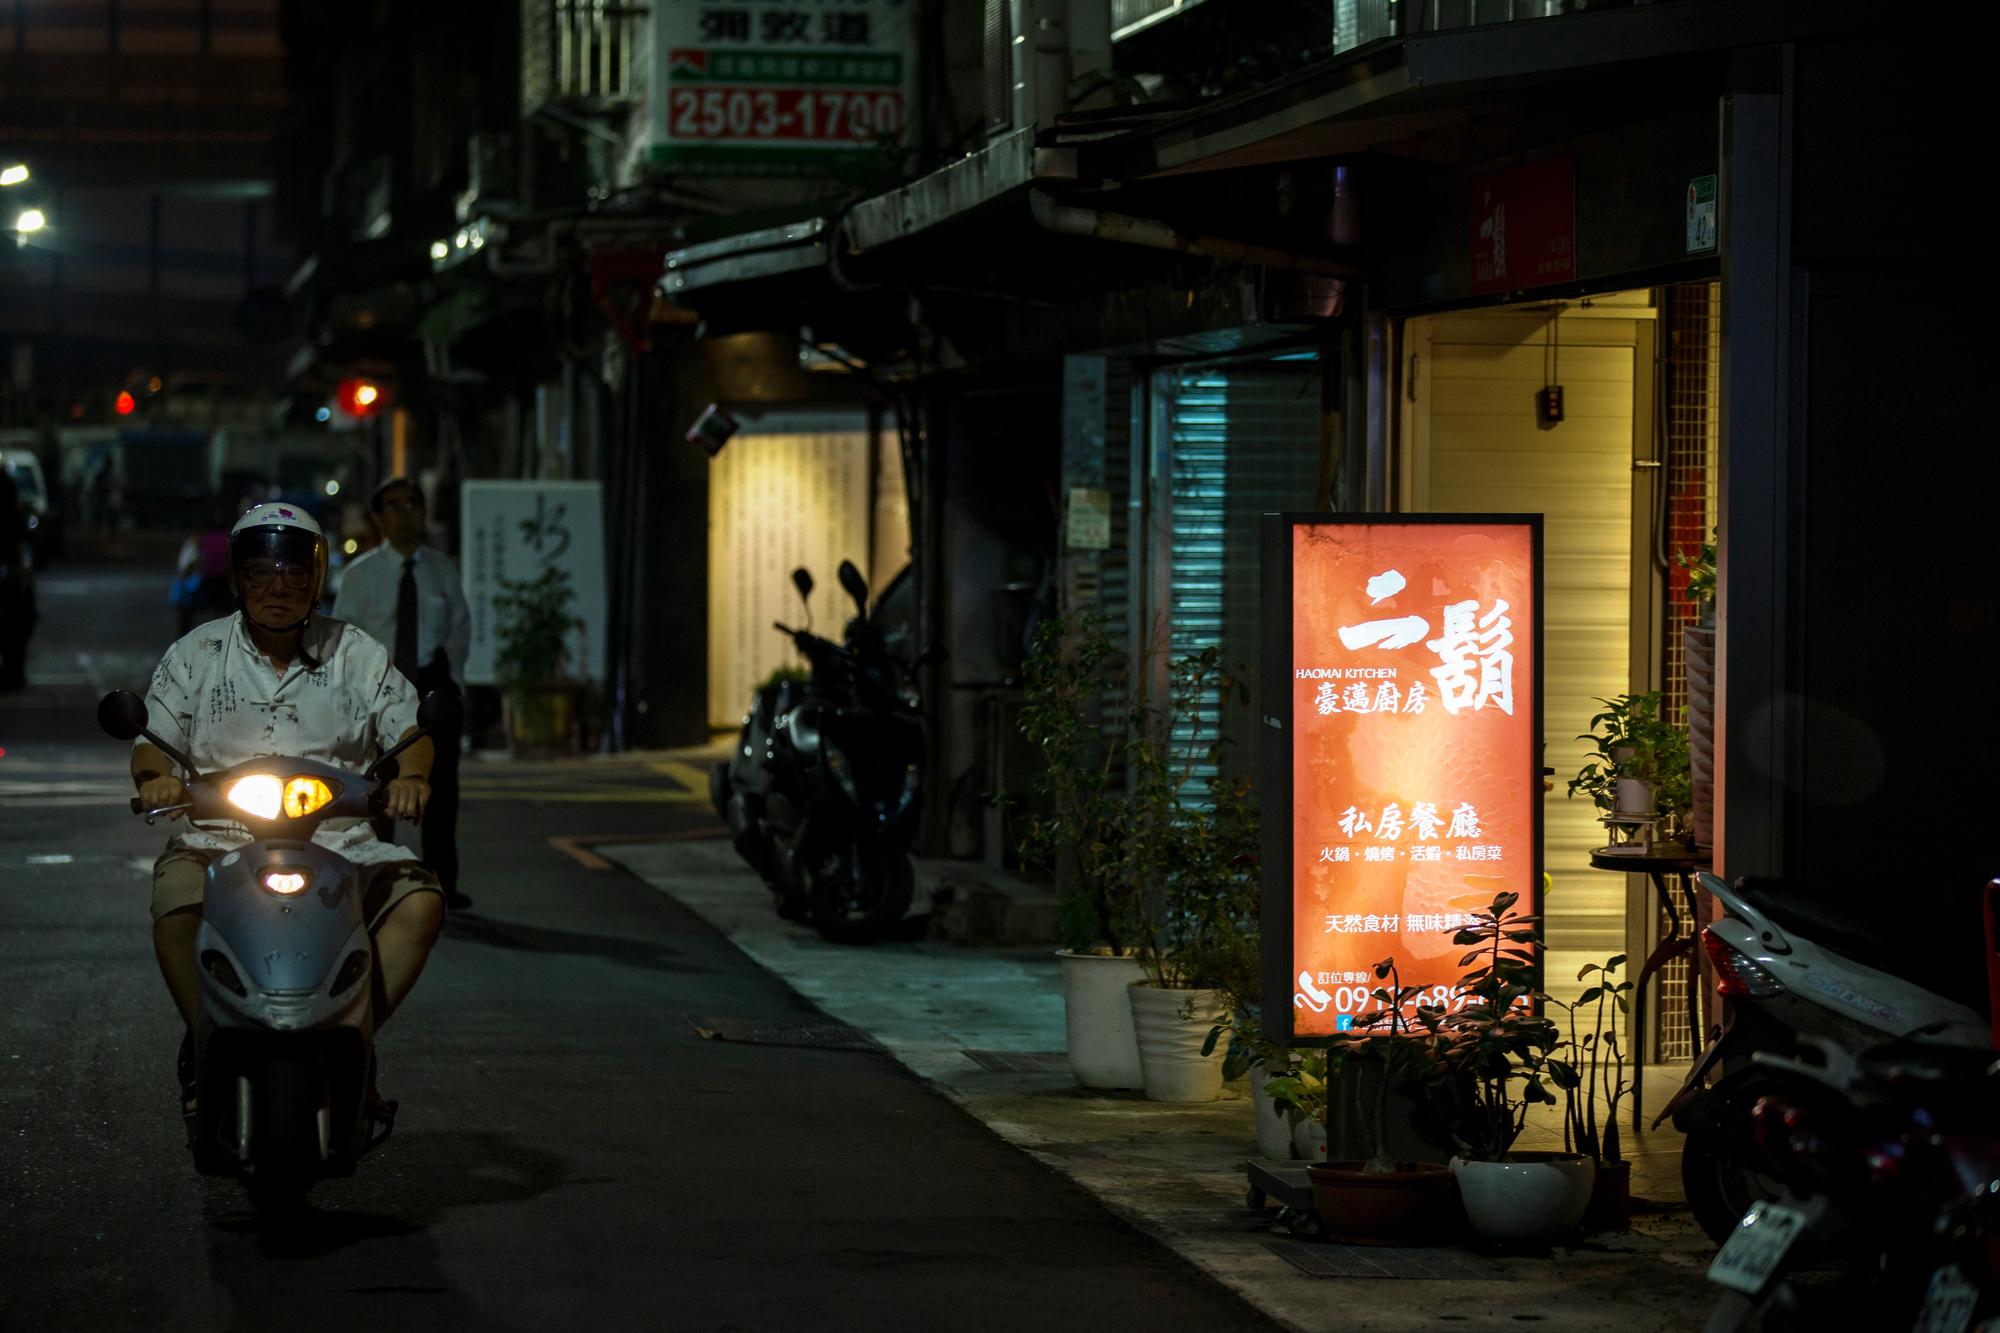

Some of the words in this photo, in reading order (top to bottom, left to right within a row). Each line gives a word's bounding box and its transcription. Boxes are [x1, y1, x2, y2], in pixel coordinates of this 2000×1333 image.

[1295, 668, 1342, 679] HAOMAI
[1345, 668, 1397, 679] KITCHEN
[1314, 681, 1430, 715] 豪邁廚房
[1337, 801, 1483, 841] 私房餐廳
[1325, 913, 1400, 933] 天然食材
